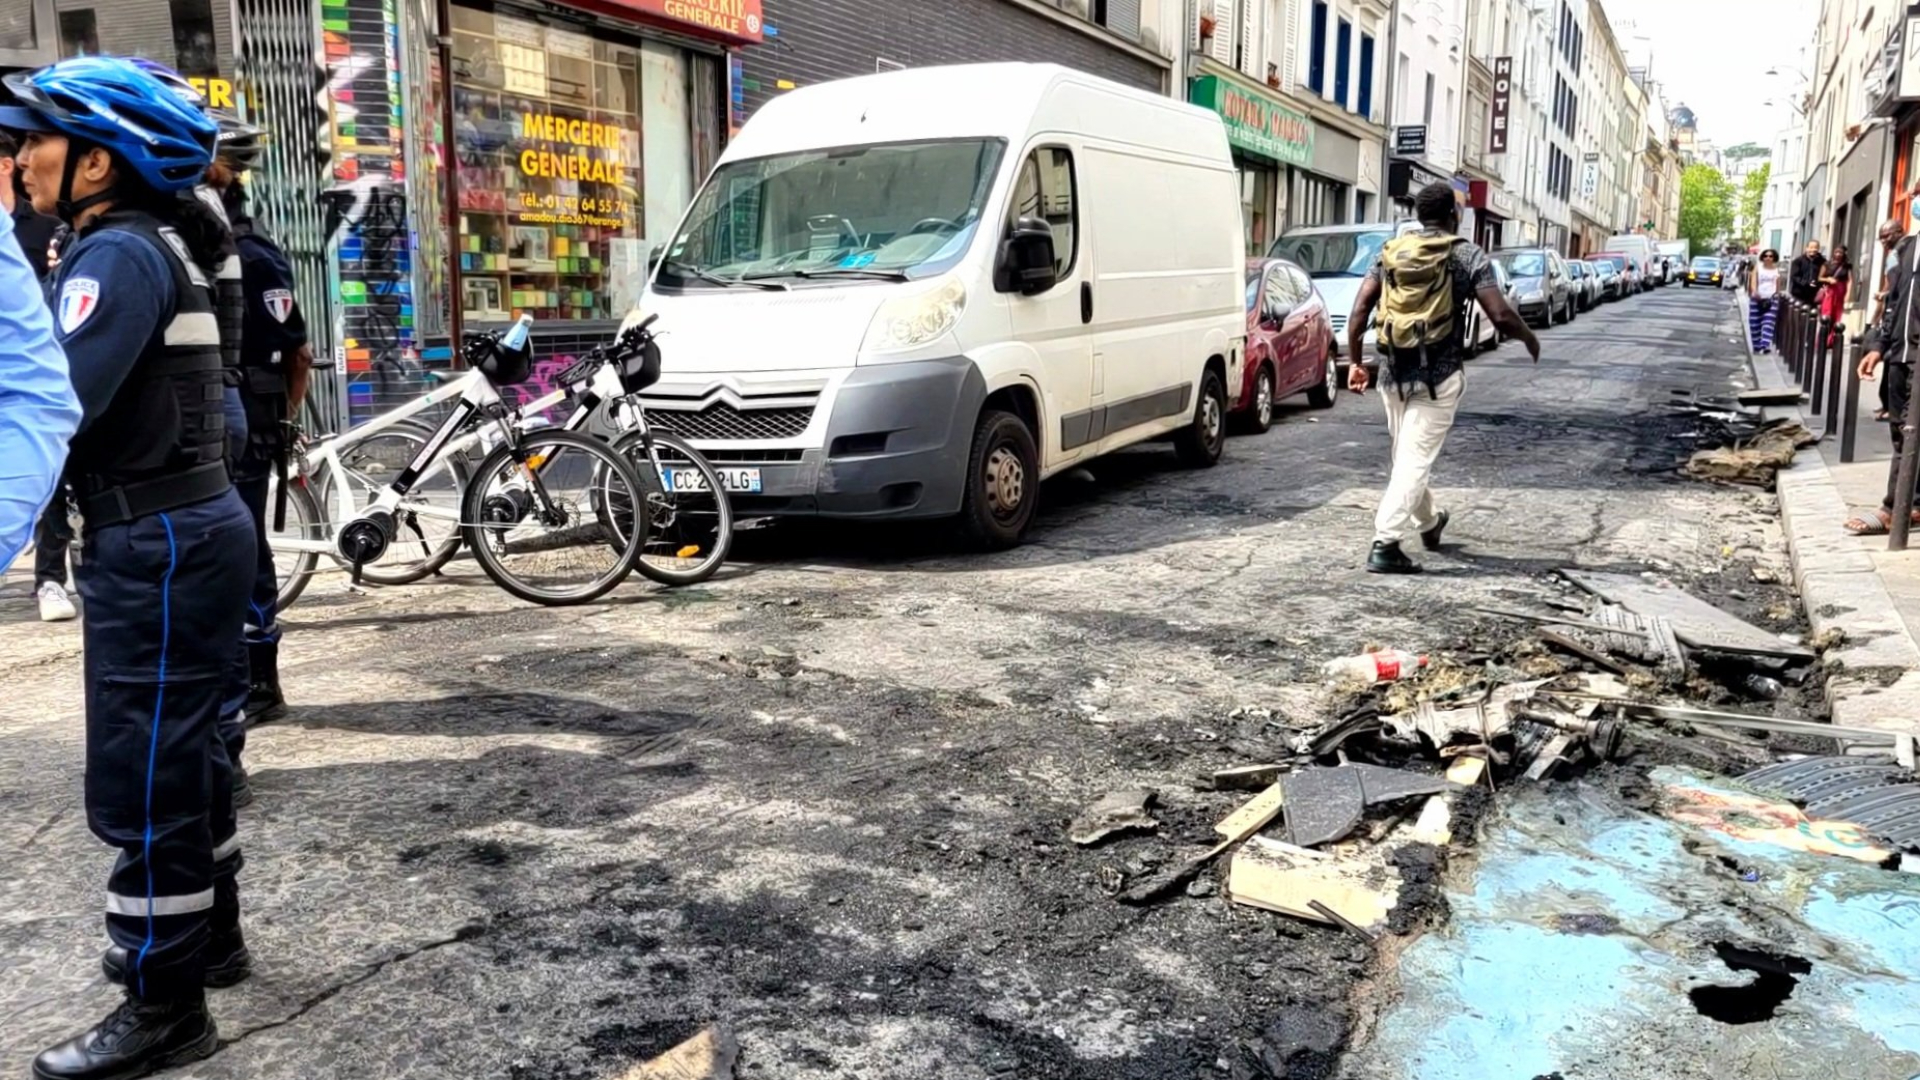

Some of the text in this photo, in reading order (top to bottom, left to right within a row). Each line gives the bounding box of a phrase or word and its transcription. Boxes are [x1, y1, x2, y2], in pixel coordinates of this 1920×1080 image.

[1493, 61, 1510, 148] HOTEL
[524, 112, 621, 150] MERCERIE
[521, 143, 624, 184] GÉNÉRALE
[547, 195, 560, 209] 01
[582, 198, 595, 212] 64
[598, 199, 612, 213] 55
[674, 471, 750, 490] CC-22-LG
